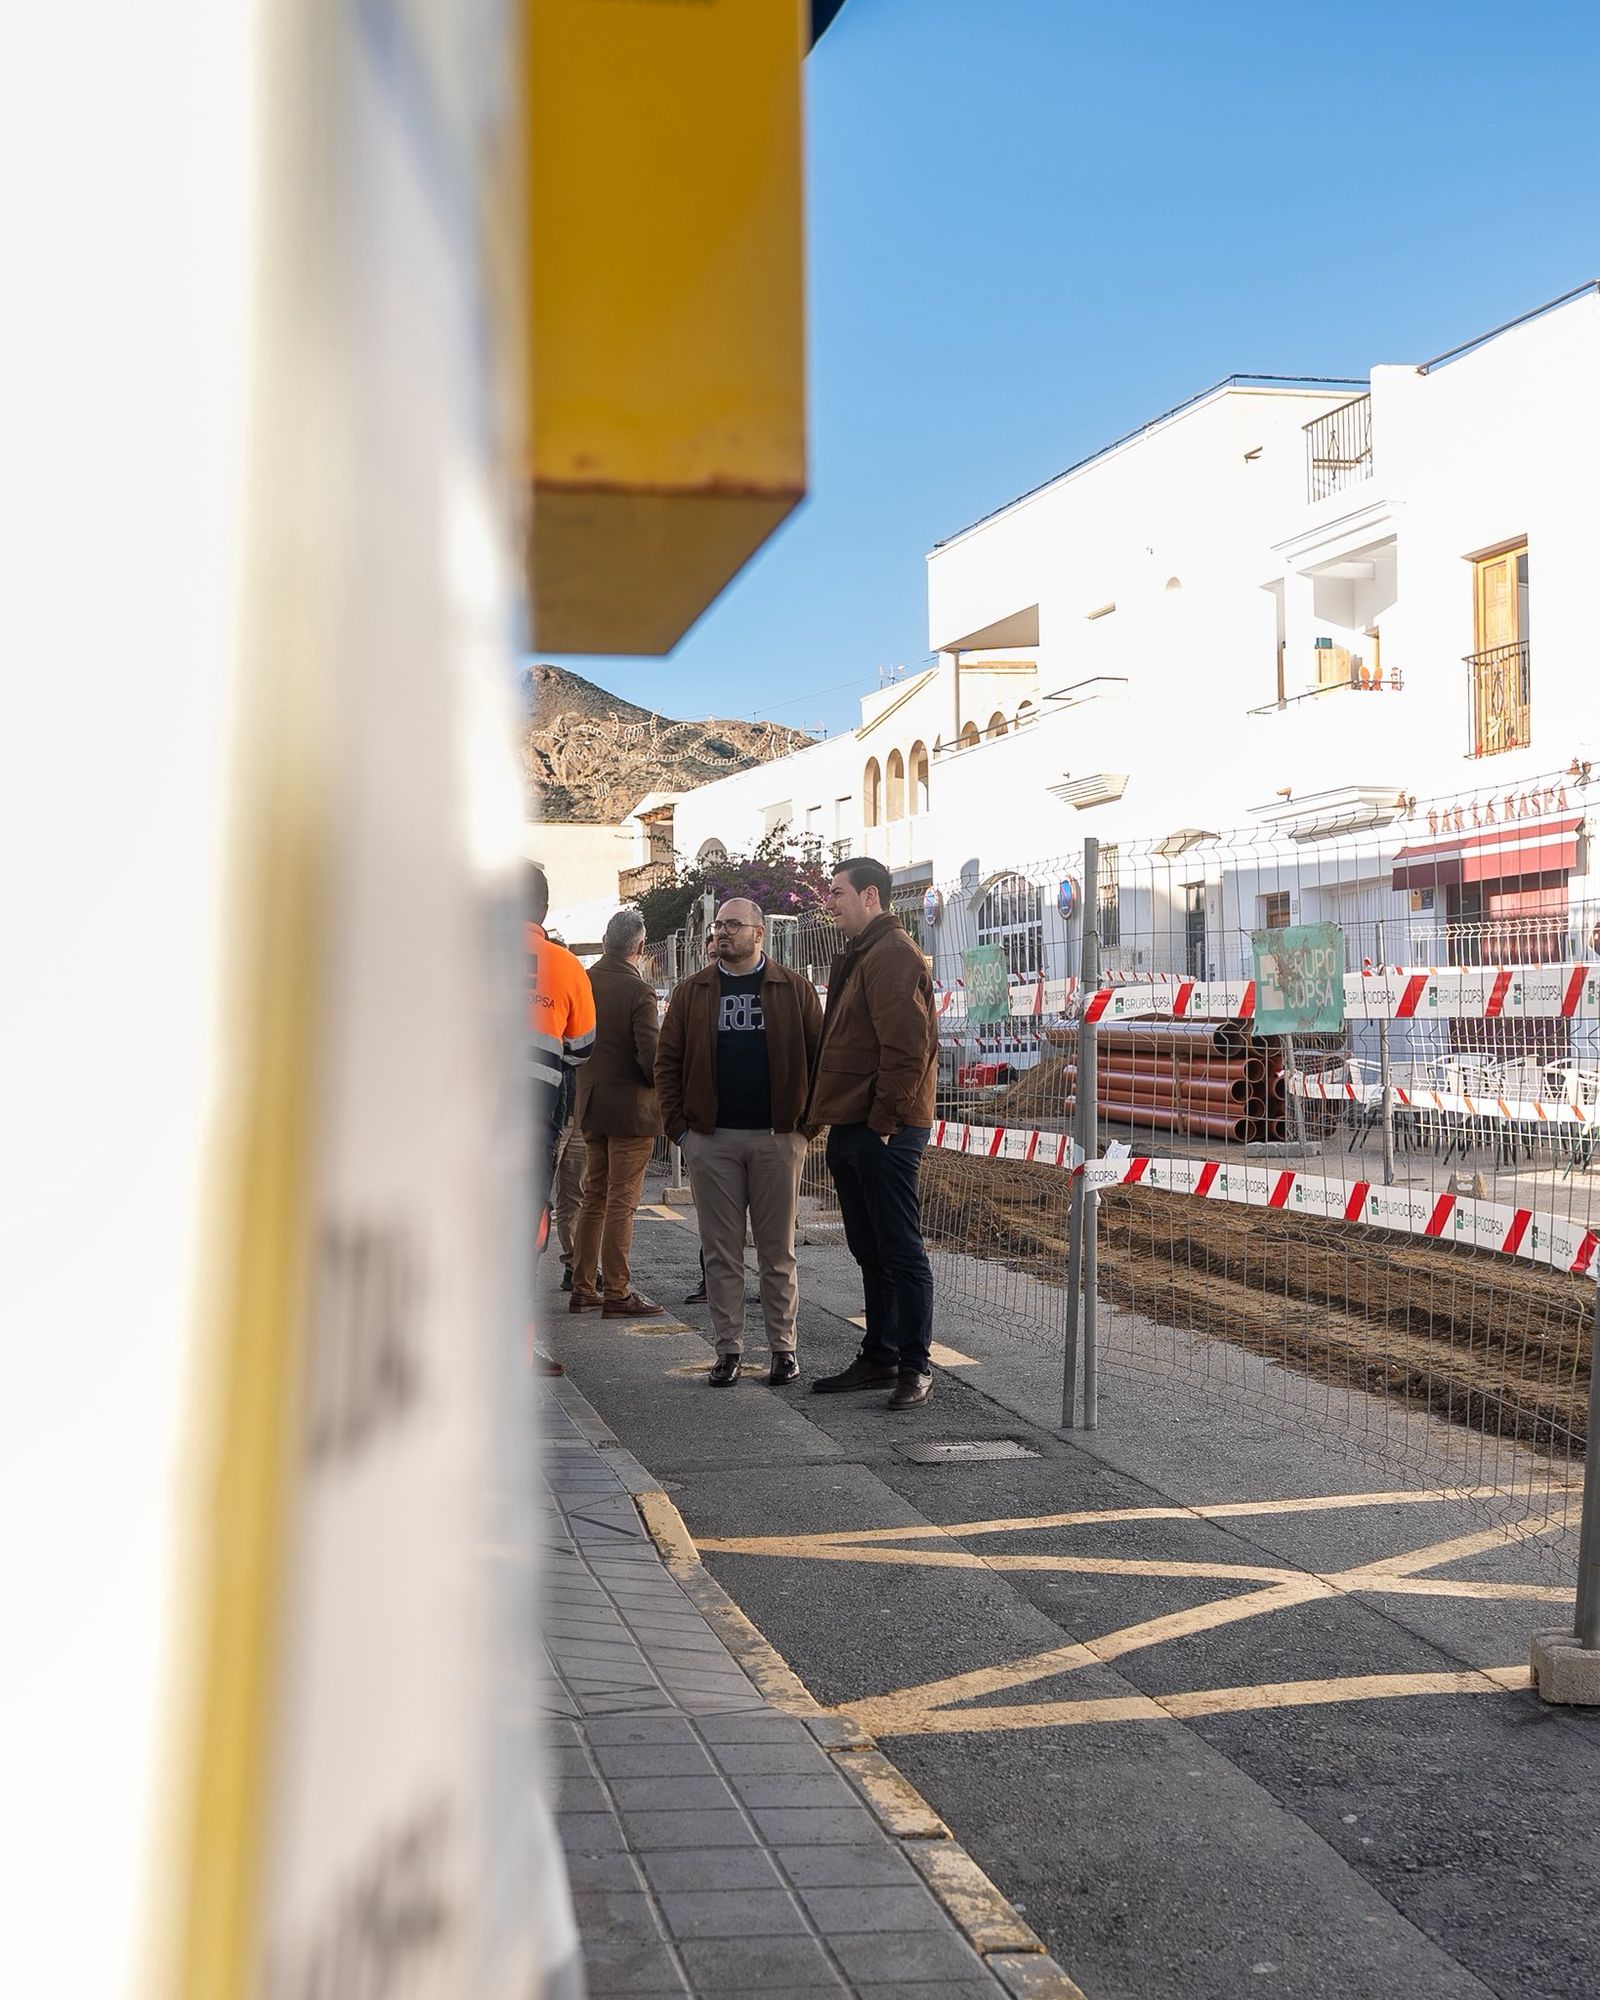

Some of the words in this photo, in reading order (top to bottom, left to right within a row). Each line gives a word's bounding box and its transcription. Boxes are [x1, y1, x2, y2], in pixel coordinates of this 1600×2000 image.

[1428, 806, 1465, 834] BAR
[1472, 802, 1495, 826] LA
[1504, 786, 1569, 820] RASPA
[1380, 1200, 1427, 1220] GRUPOCOPSA
